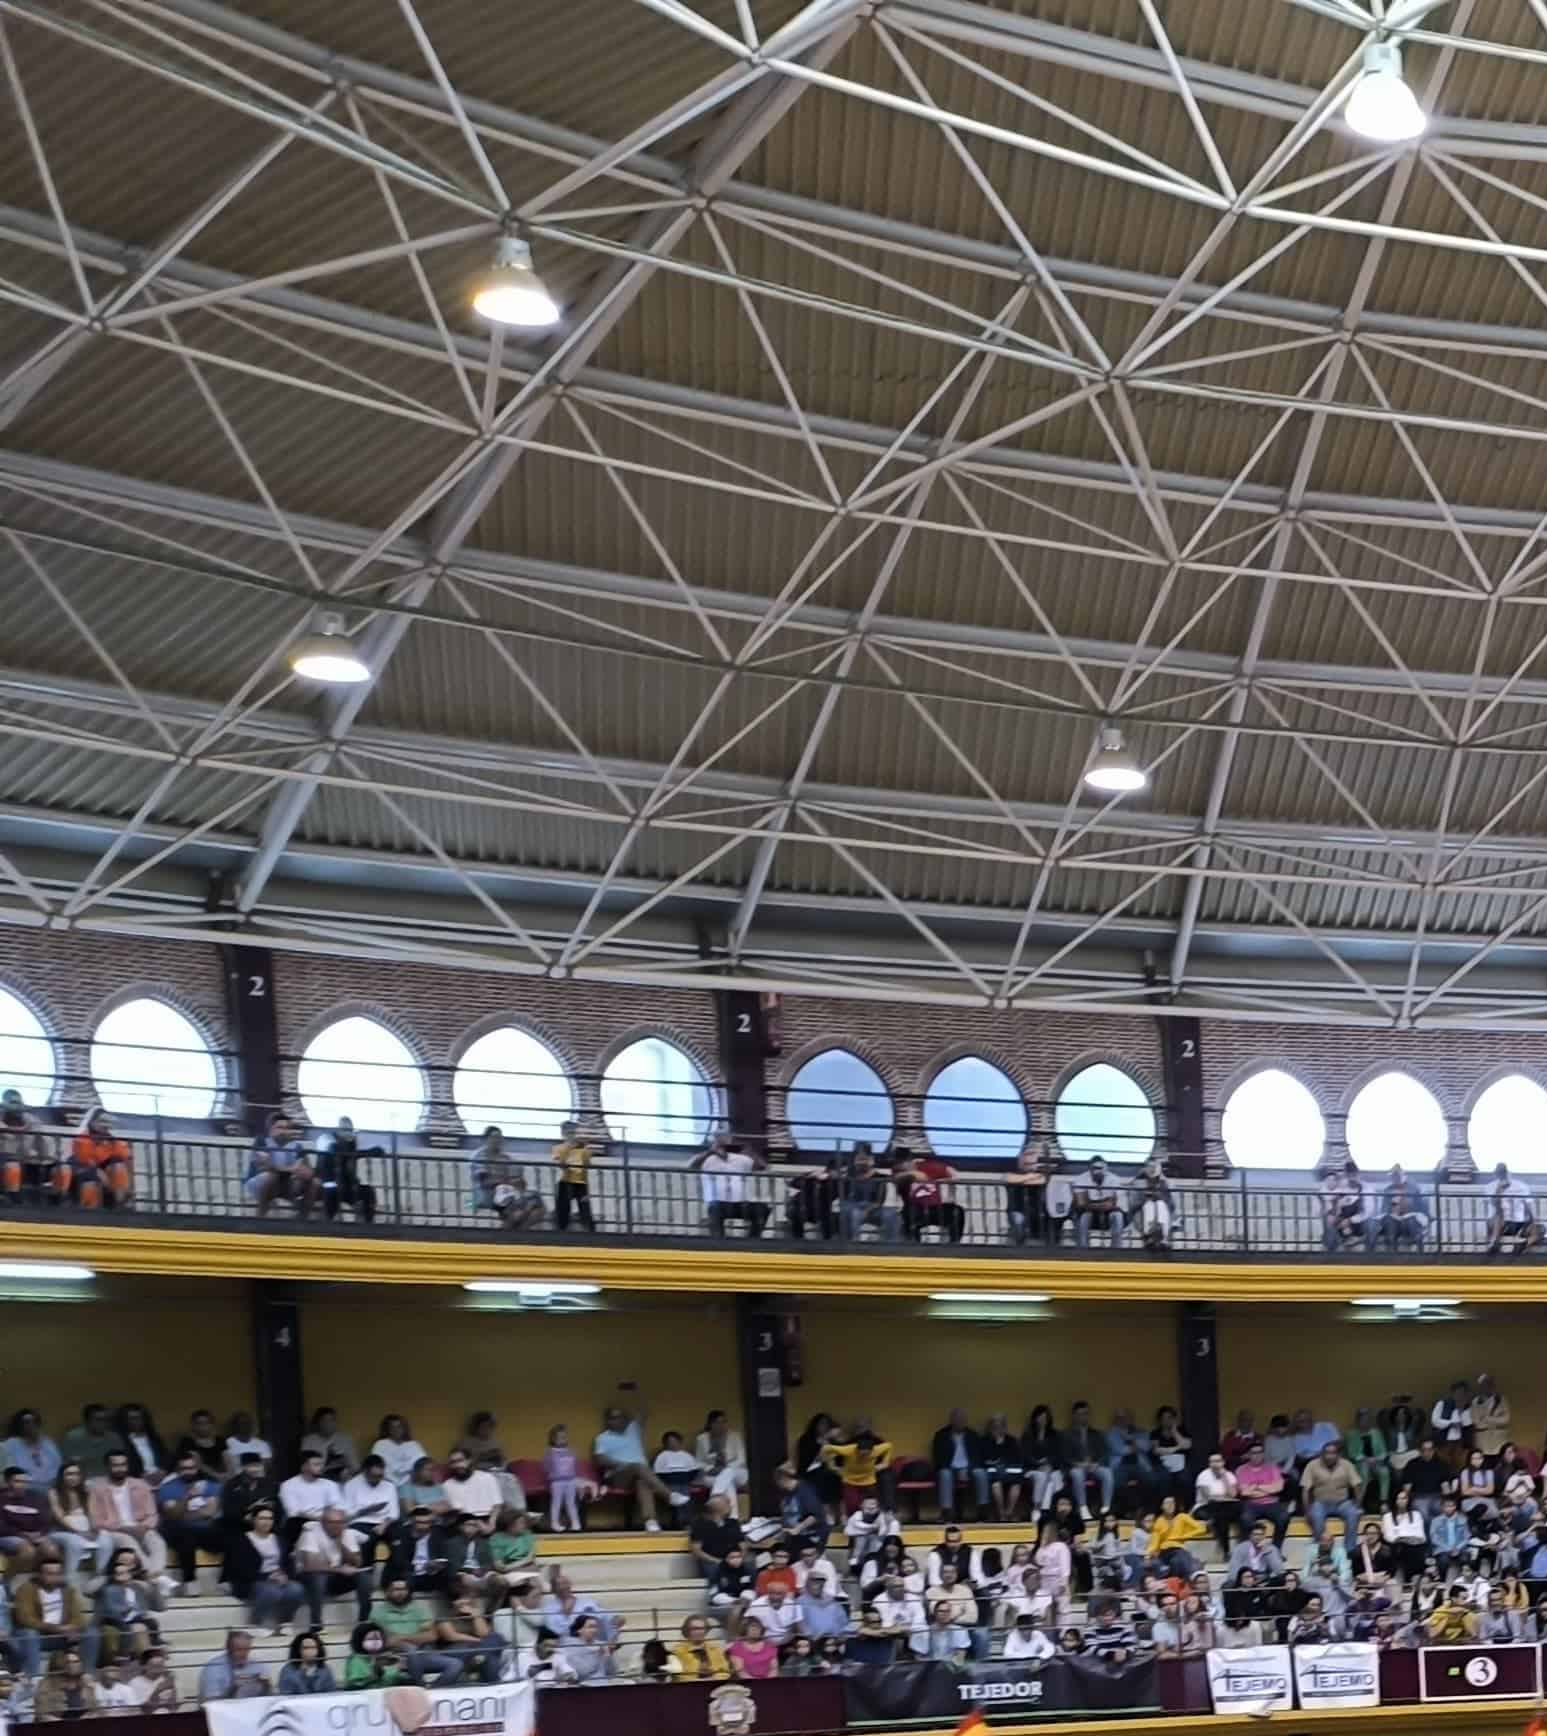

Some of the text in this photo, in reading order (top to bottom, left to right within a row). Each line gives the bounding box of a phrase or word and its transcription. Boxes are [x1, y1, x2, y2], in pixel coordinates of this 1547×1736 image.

[248, 975, 265, 997] 2
[736, 1013, 752, 1033] 2
[1181, 1039, 1196, 1058] 2
[757, 1331, 774, 1352] 3
[1223, 1668, 1288, 1693] TEJEMO
[1311, 1664, 1375, 1689] TEJEMO
[1472, 1657, 1490, 1684] 3
[957, 1681, 1043, 1700] TEJEDOR
